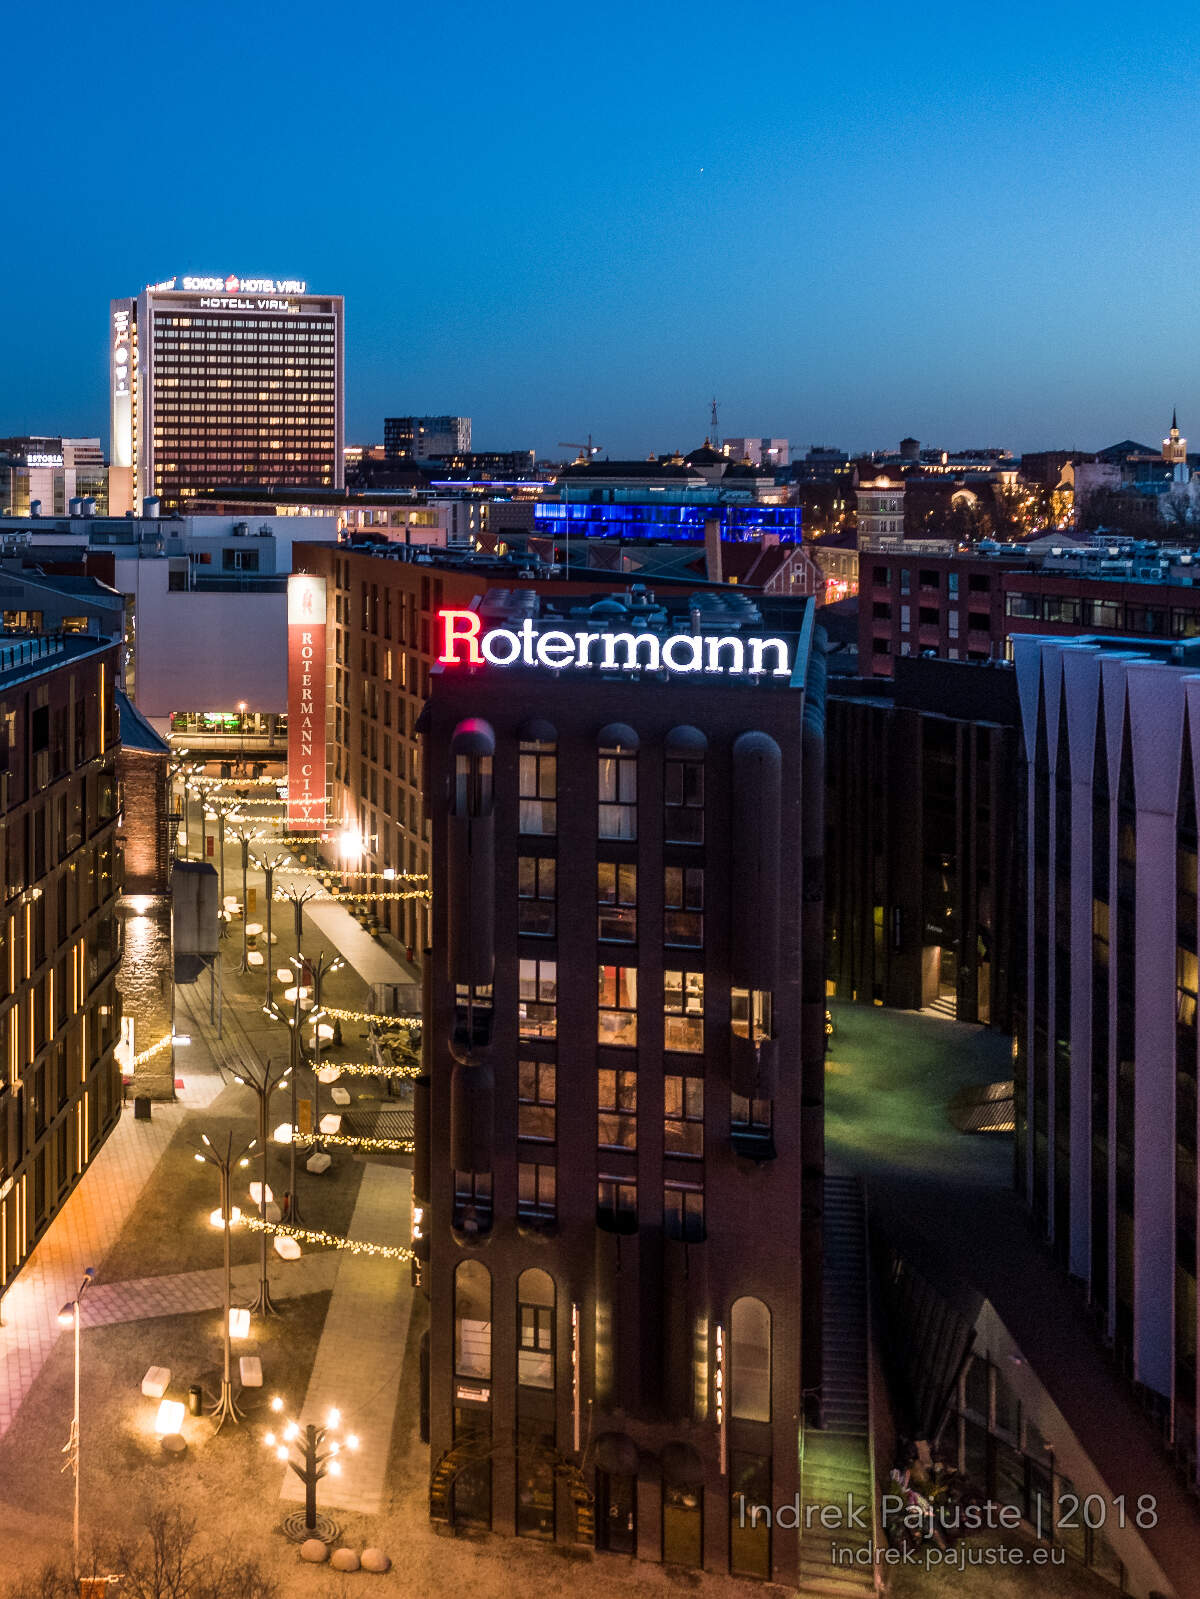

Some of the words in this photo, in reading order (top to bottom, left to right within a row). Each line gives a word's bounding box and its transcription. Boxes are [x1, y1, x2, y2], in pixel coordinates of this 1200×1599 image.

[182, 277, 225, 291] SOKOS
[240, 279, 277, 293] HOTEL
[277, 281, 306, 294] VIRU
[200, 297, 255, 309] HOTELL
[257, 299, 289, 310] VIRU
[437, 609, 792, 676] Rotermann
[300, 632, 314, 756] ROTERMANN
[301, 764, 313, 819] CITY
